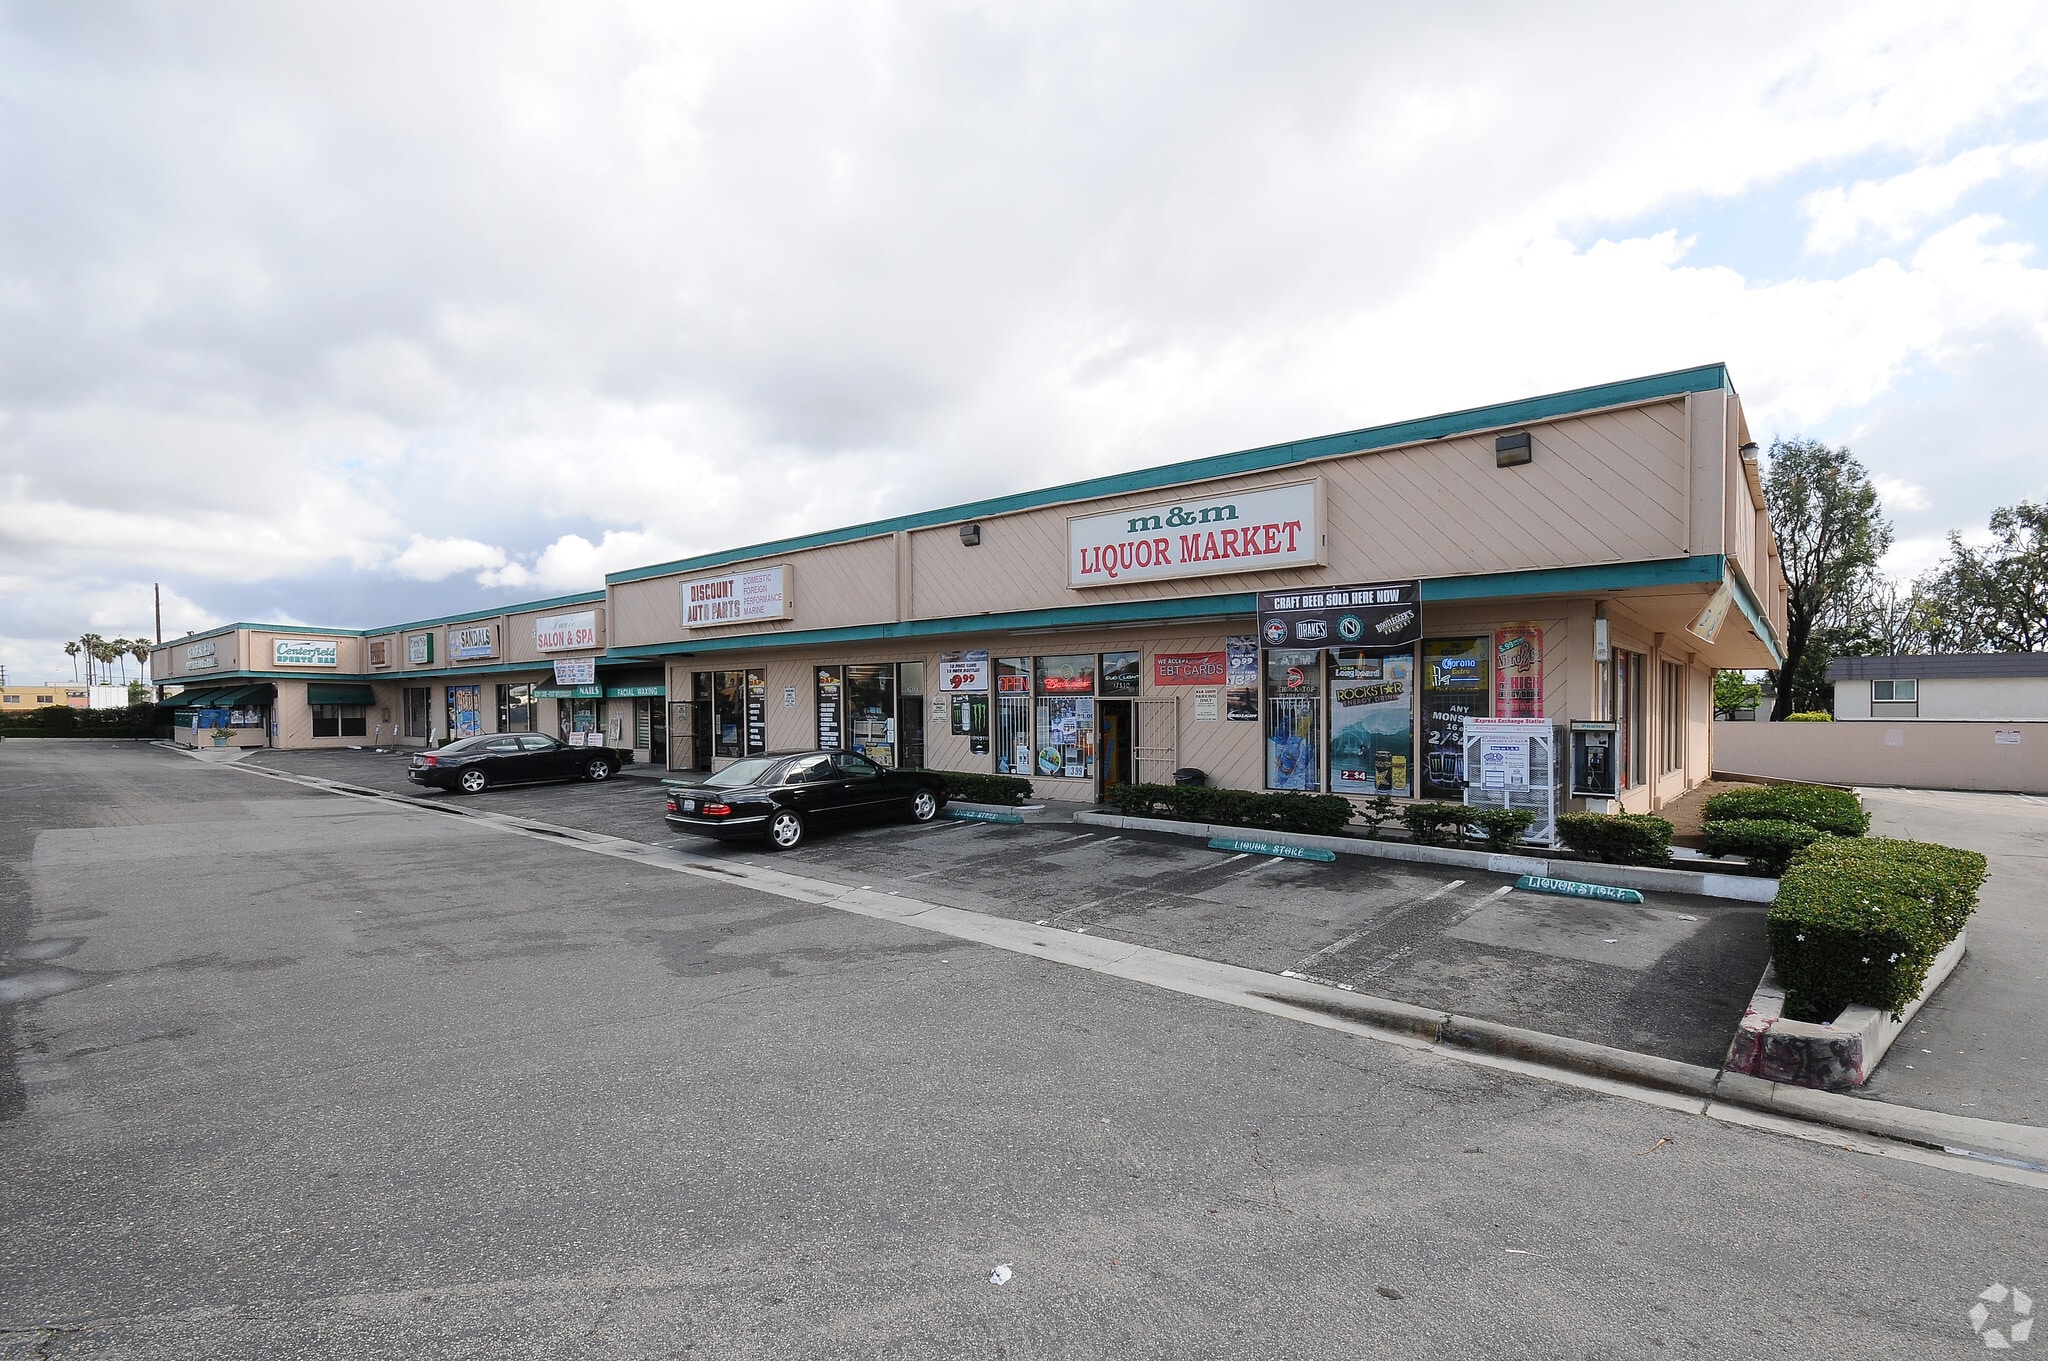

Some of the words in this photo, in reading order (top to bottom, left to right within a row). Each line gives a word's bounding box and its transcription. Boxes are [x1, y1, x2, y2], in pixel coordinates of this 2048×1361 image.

[1080, 537, 1172, 579] LIQUOR
[1179, 519, 1302, 564] MARKET
[742, 573, 772, 585] DOMESTIC
[690, 579, 734, 602] DISCOUNT
[743, 584, 768, 595] FOREIGN
[743, 592, 783, 605] PERFORMANCE
[1274, 596, 1301, 610] CRAFT
[1302, 594, 1324, 608] BEER
[1325, 592, 1350, 607] SOLD
[1351, 591, 1375, 605] HERE
[1376, 588, 1400, 603] NOW
[687, 604, 710, 623] AUTO
[711, 599, 741, 619] PARTS
[743, 605, 765, 616] MARINE
[460, 629, 491, 648] SANDALS
[538, 631, 565, 648] SALON
[567, 630, 574, 646] &
[575, 628, 594, 645] SPA
[276, 642, 336, 657] Centerfield
[276, 656, 313, 664] SPORTS
[317, 656, 336, 664] BAR
[1280, 655, 1311, 666] ATM
[1441, 658, 1476, 669] Corona
[1160, 665, 1182, 676] EBT
[1183, 663, 1224, 676] CARDS
[999, 676, 1029, 691] OPEN
[1302, 685, 1316, 693] TOP
[1510, 676, 1540, 689] HIGH
[579, 686, 600, 696] NAILS
[617, 688, 635, 697] FACIAL
[637, 687, 658, 696] WAXING
[1336, 681, 1404, 702] ROCKSTAR
[1343, 697, 1372, 707] ENERGY
[1373, 694, 1400, 703] DRINK
[1449, 705, 1470, 713] ANY
[1446, 723, 1456, 731] 16
[1342, 770, 1349, 779] 2
[1354, 771, 1366, 780] $4
[1234, 840, 1267, 851] LIQUOR
[1272, 845, 1305, 857] STORE
[1528, 876, 1576, 892] LIQUOR
[1577, 884, 1626, 899] STORE
